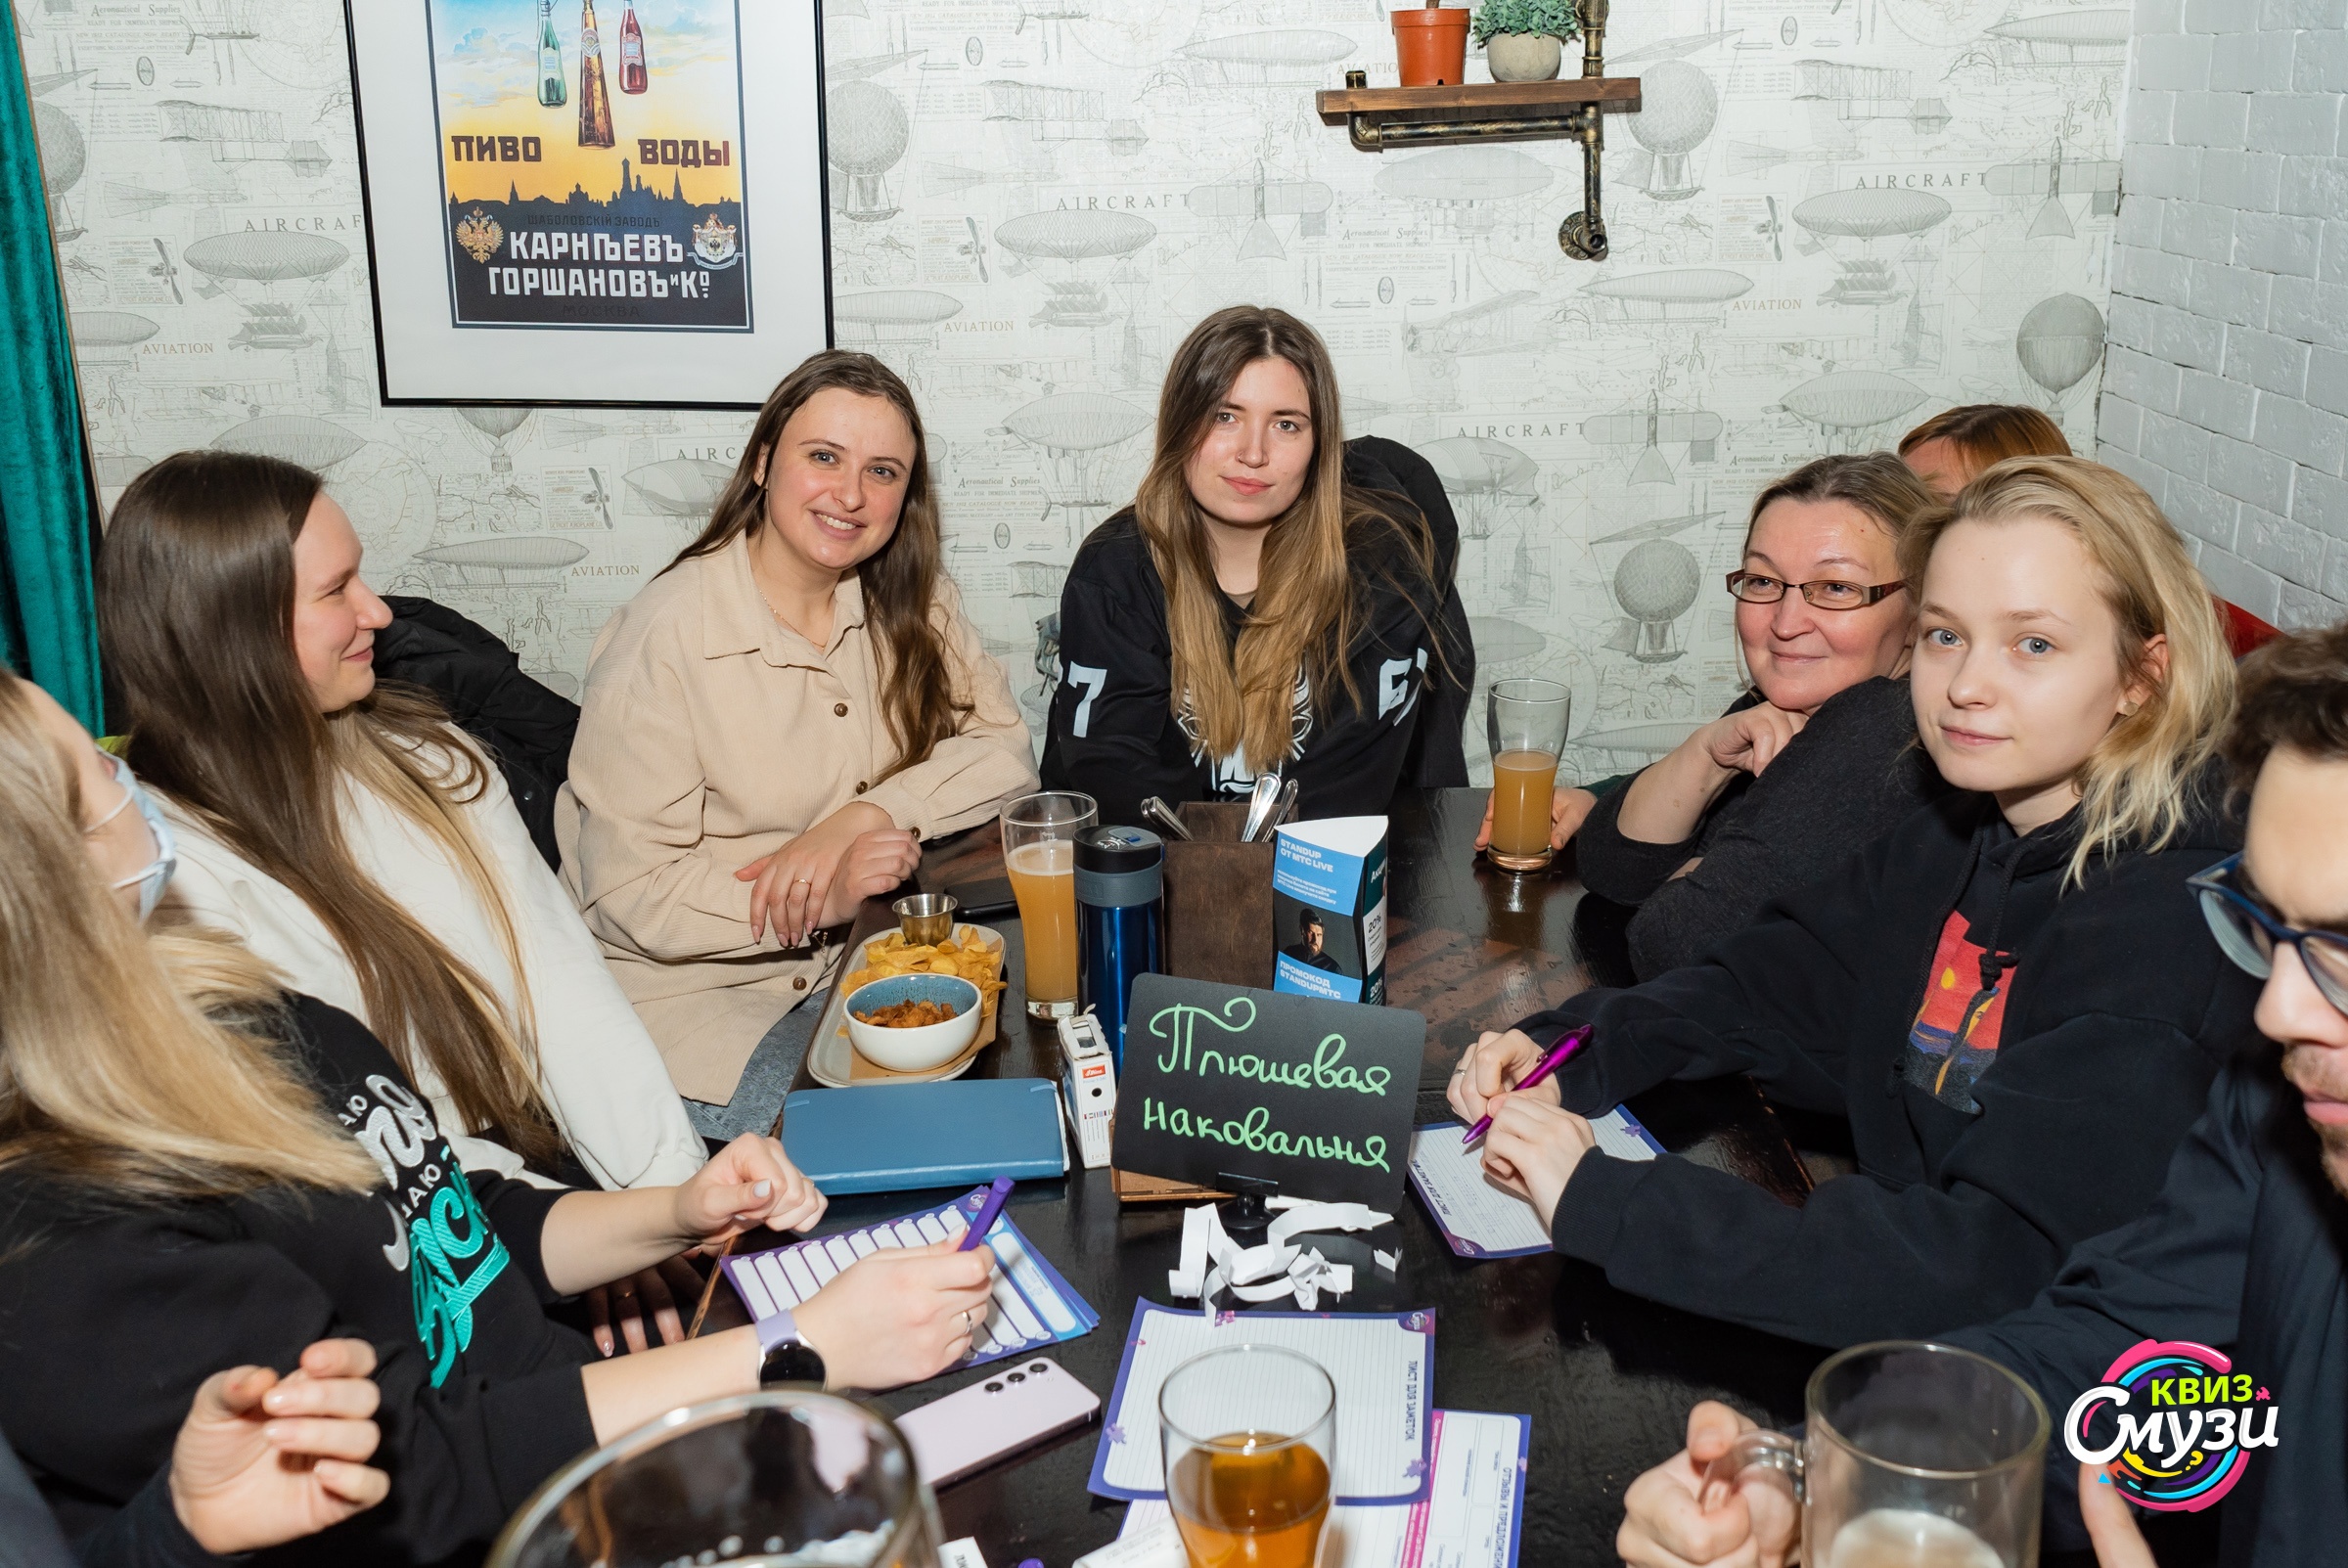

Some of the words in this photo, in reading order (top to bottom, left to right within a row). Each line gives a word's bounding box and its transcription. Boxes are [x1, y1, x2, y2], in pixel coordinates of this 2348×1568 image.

[90, 4, 141, 18] Aeronautical
[148, 4, 182, 18] Supplies
[1336, 62, 1398, 75] AVIATIO
[451, 135, 542, 162] ПИВО
[637, 138, 731, 168] ВОДЫ
[1855, 172, 1987, 189] AIRCRAFT
[1056, 194, 1190, 211] AIRCRAFT
[244, 214, 362, 233] AIRCRAF
[614, 214, 661, 228] ЗАВОДЪ
[1341, 227, 1390, 241] Aeronautical
[488, 267, 669, 298] ГОРШАНОВЪ
[562, 304, 642, 319] МОСКВА
[1732, 298, 1802, 312] AVIATION
[943, 320, 1015, 334] AVIATION
[142, 342, 214, 355] AVIATION
[1457, 422, 1585, 438] AIRCRAFT
[677, 446, 737, 461] AIRC
[1729, 453, 1776, 467] Aeronautical
[957, 475, 1004, 488] Aeronautical
[1010, 475, 1041, 488] Supplies
[570, 564, 641, 577] AVIATION
[1058, 660, 1108, 739] 7
[1280, 838, 1322, 859] STANDUP
[1312, 860, 1333, 873] LIVE
[1280, 960, 1331, 989] ПРОМОКОД
[1149, 996, 1391, 1097] Плюшевая
[1143, 1097, 1391, 1173] наковальня
[1406, 1361, 1419, 1382] ЛИСТ
[1405, 1384, 1418, 1400] ДЛЯ
[1405, 1401, 1418, 1441] ЗАМЕТОК
[1499, 1466, 1513, 1501] ОТЗЫВЫ
